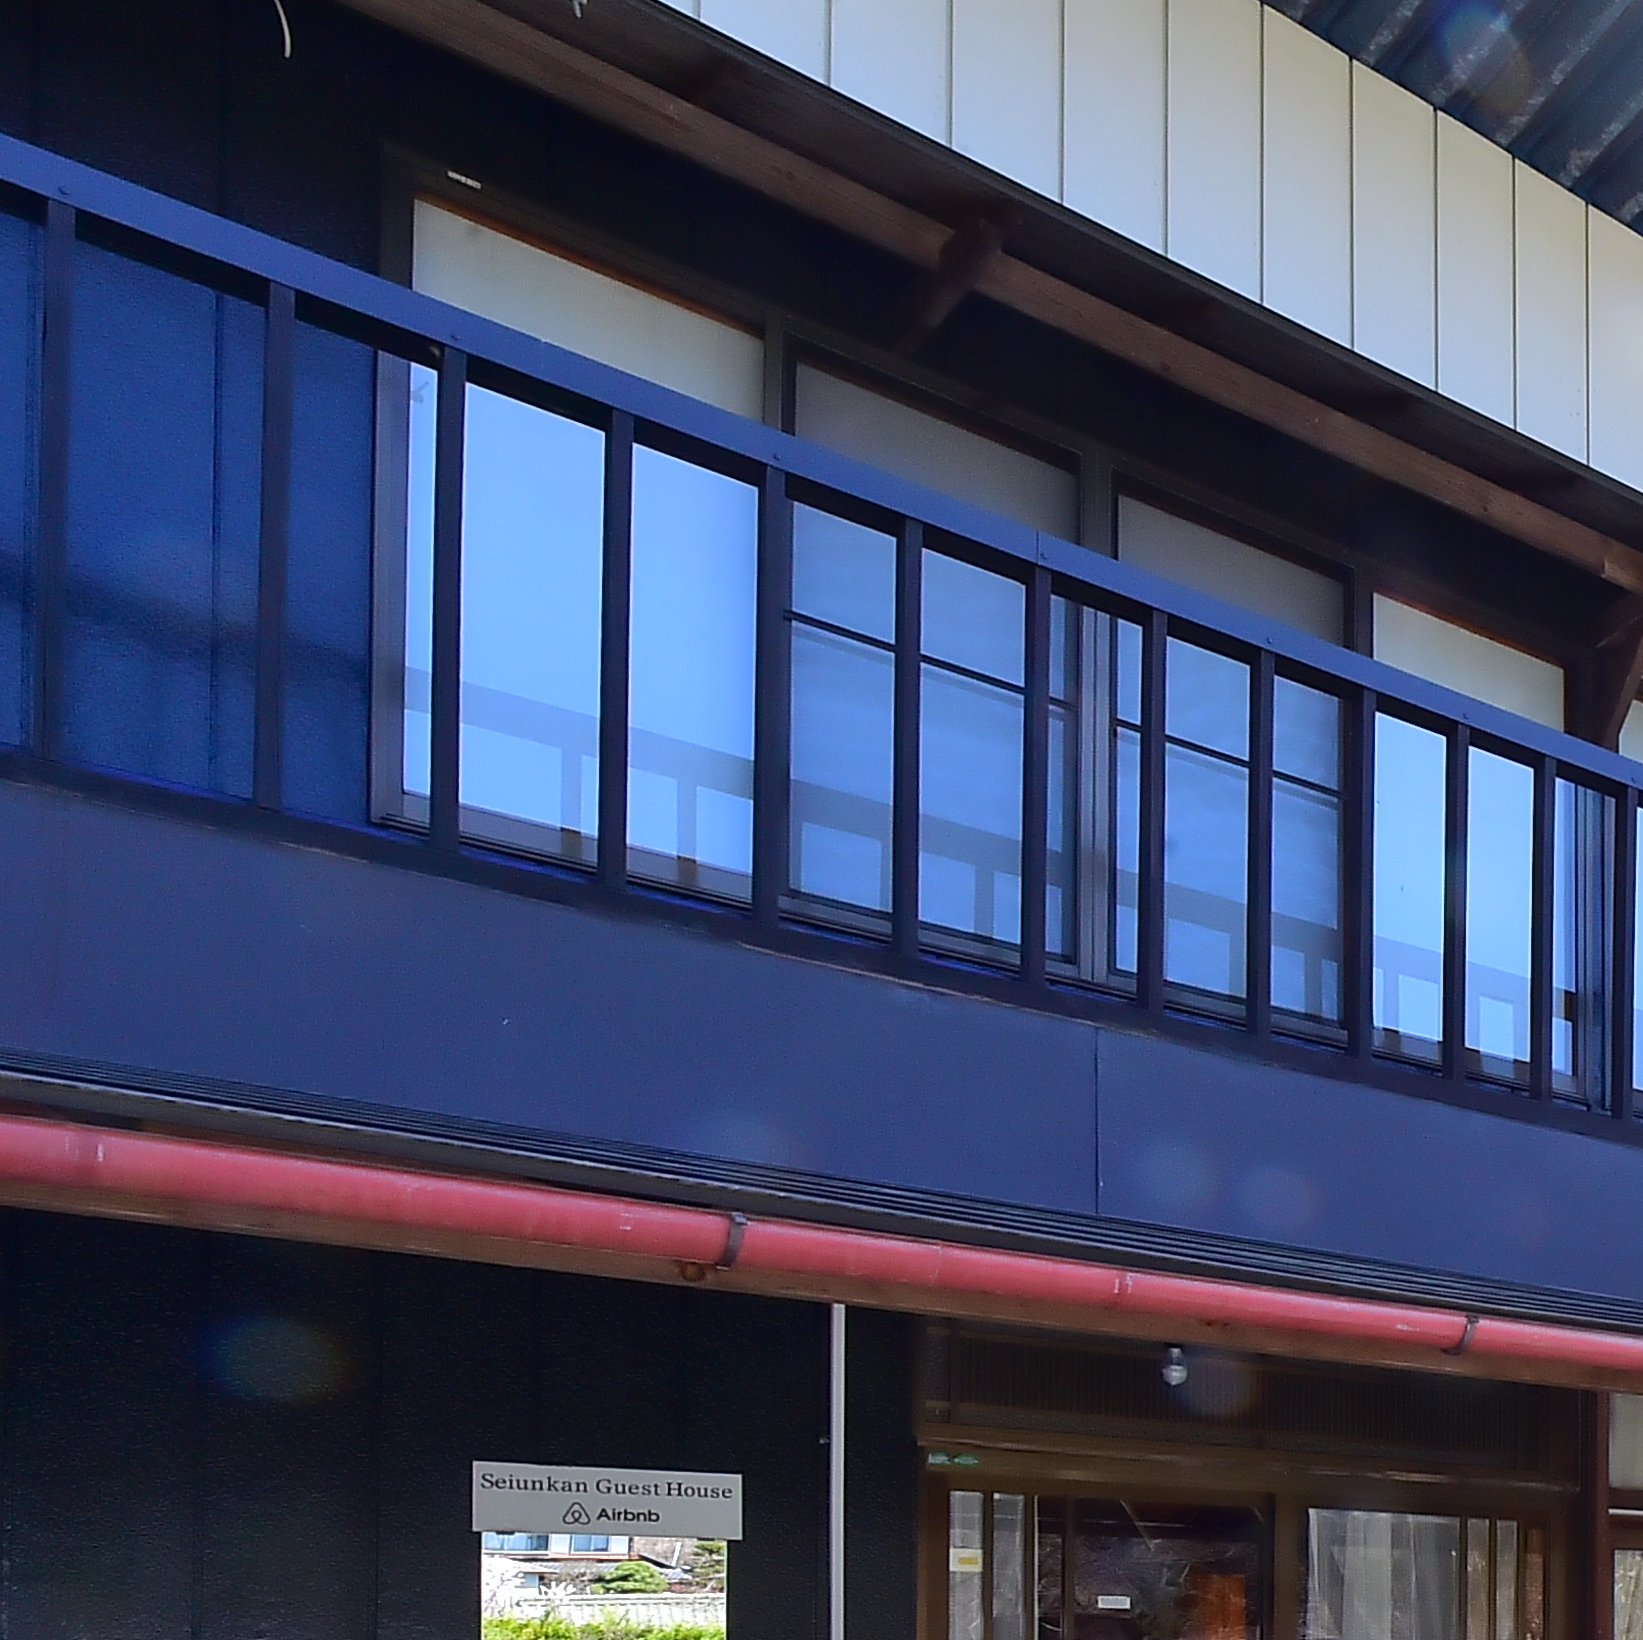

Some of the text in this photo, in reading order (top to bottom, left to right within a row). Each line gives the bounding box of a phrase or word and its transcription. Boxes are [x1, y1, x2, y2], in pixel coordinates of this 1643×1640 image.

[480, 1473, 733, 1499] Seiunkan Guest House
[596, 1507, 660, 1523] Airbnb
